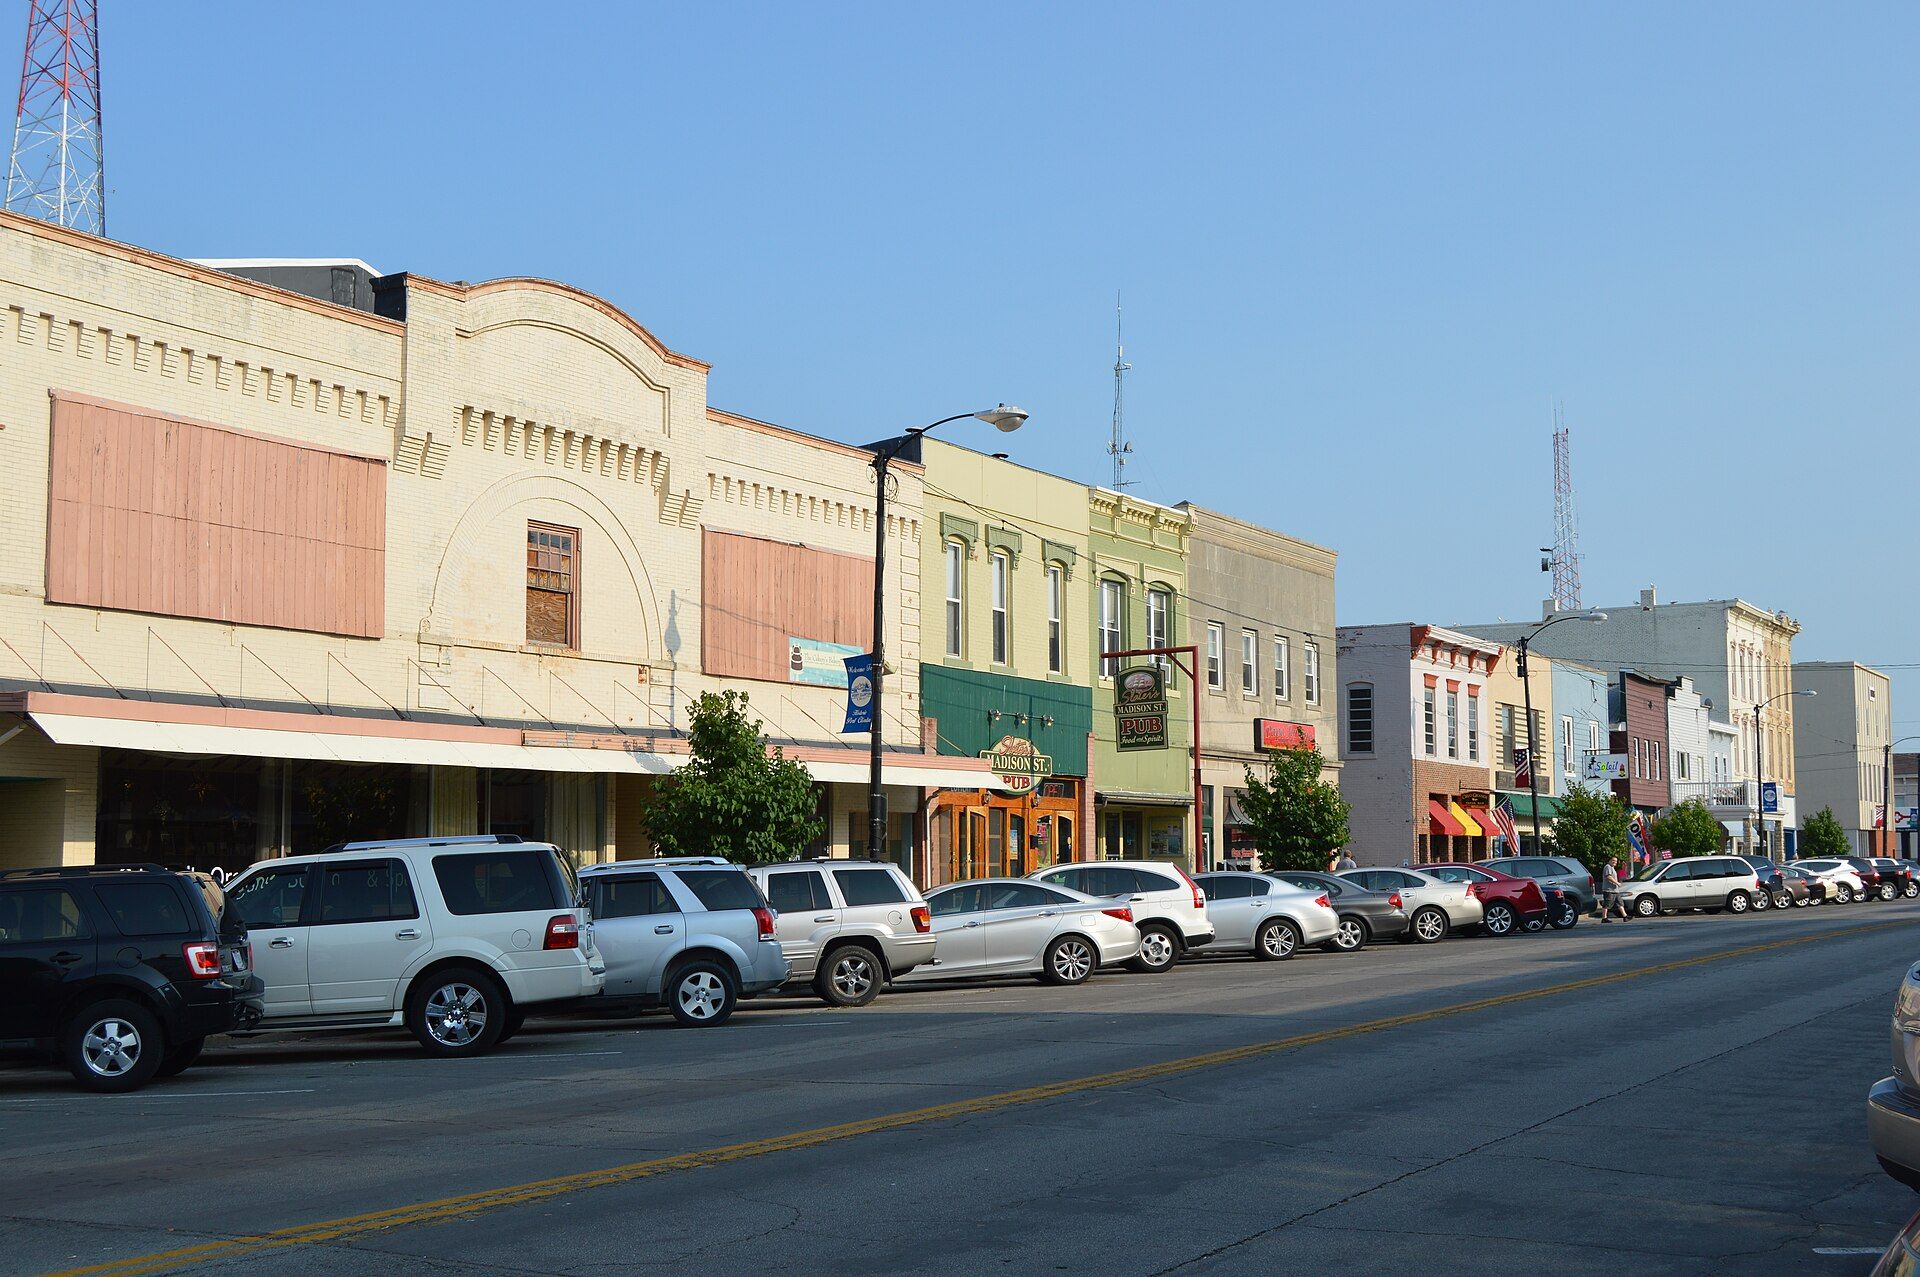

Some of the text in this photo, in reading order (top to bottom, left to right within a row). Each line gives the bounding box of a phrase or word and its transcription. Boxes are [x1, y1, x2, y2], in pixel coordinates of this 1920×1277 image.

[1117, 703, 1166, 714] MADISON ST.
[1121, 717, 1163, 735] PUB
[1121, 735, 1136, 744] Food
[1143, 735, 1163, 744] Spirits
[986, 755, 1048, 772] MADISON ST.
[1595, 761, 1619, 771] Soleil
[1002, 775, 1031, 790] PUB
